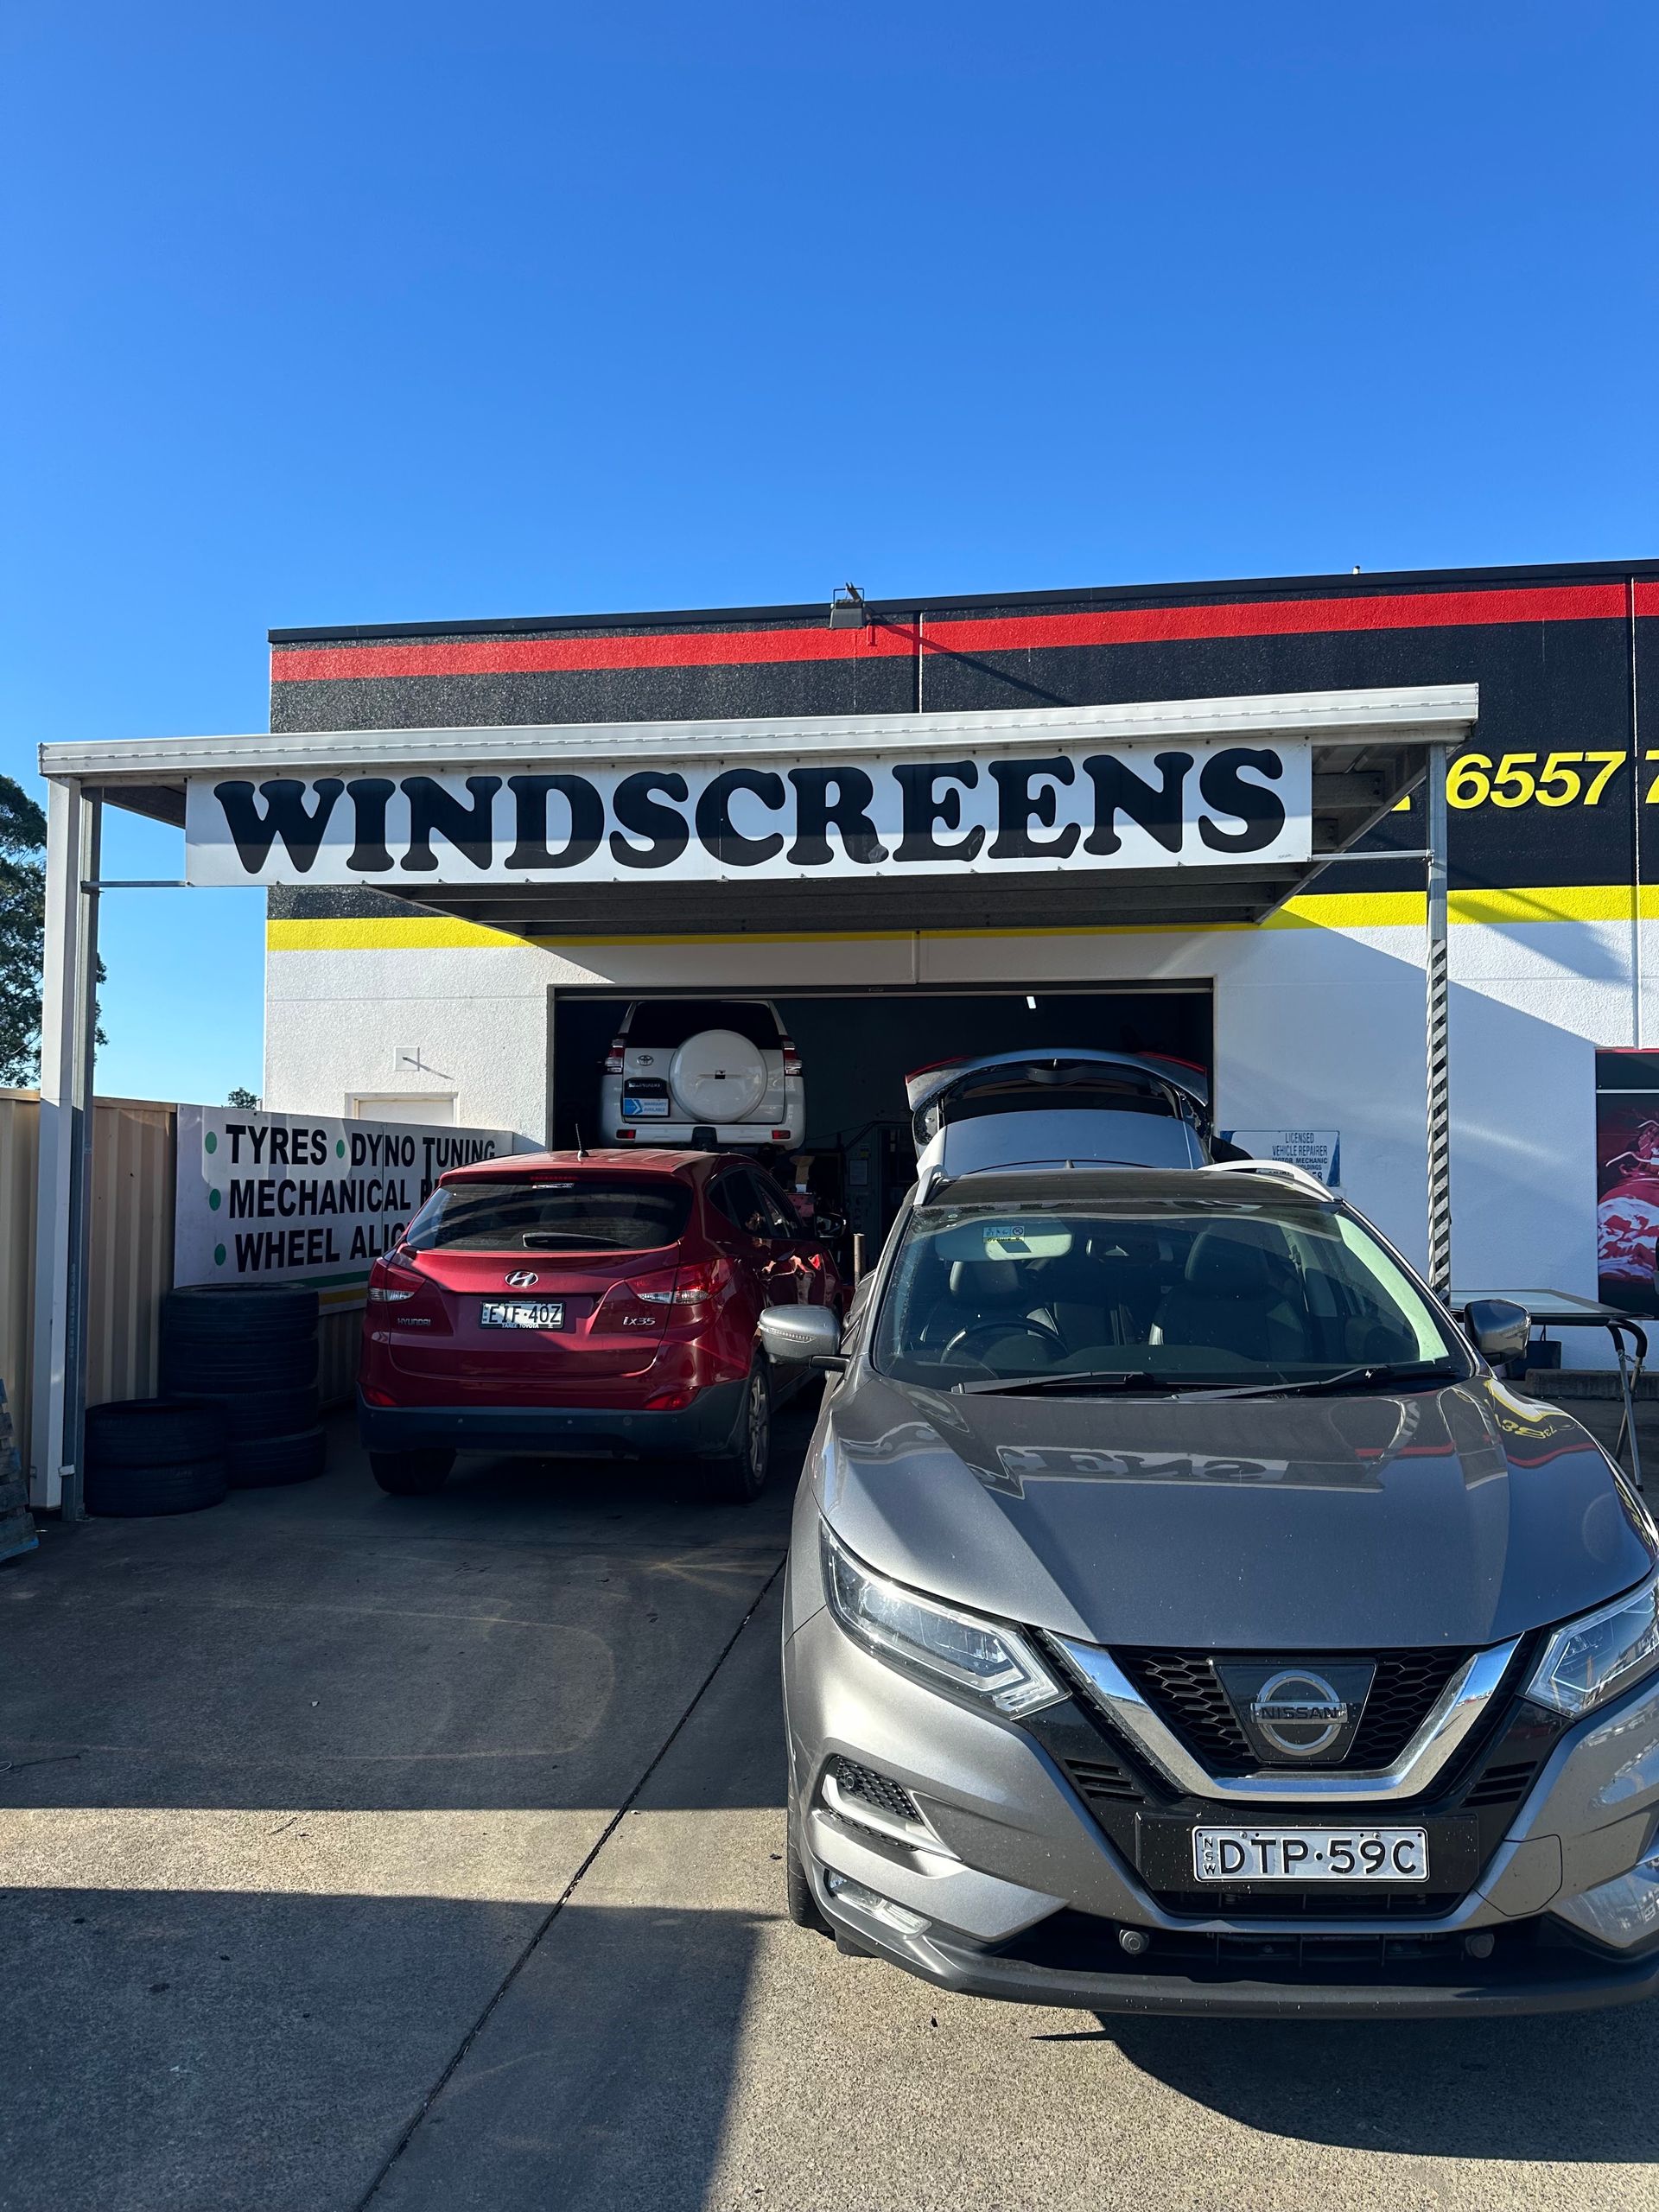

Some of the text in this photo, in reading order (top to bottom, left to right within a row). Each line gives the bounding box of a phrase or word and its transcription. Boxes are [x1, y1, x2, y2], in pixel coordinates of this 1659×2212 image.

[1445, 750, 1627, 810] 6557
[214, 747, 1286, 874] WINDSCREENS
[226, 1124, 496, 1171] TYRES DYNO TUNING
[1272, 1145, 1328, 1156] VEHICLE REPAIRER
[1285, 1132, 1315, 1144] LICENSED
[229, 1179, 411, 1219] MECHANICAL
[234, 1228, 340, 1274] WHEEL
[397, 1318, 431, 1326] HYUNDAI
[623, 1316, 656, 1325] ix35
[1261, 1706, 1338, 1719] NISSAN
